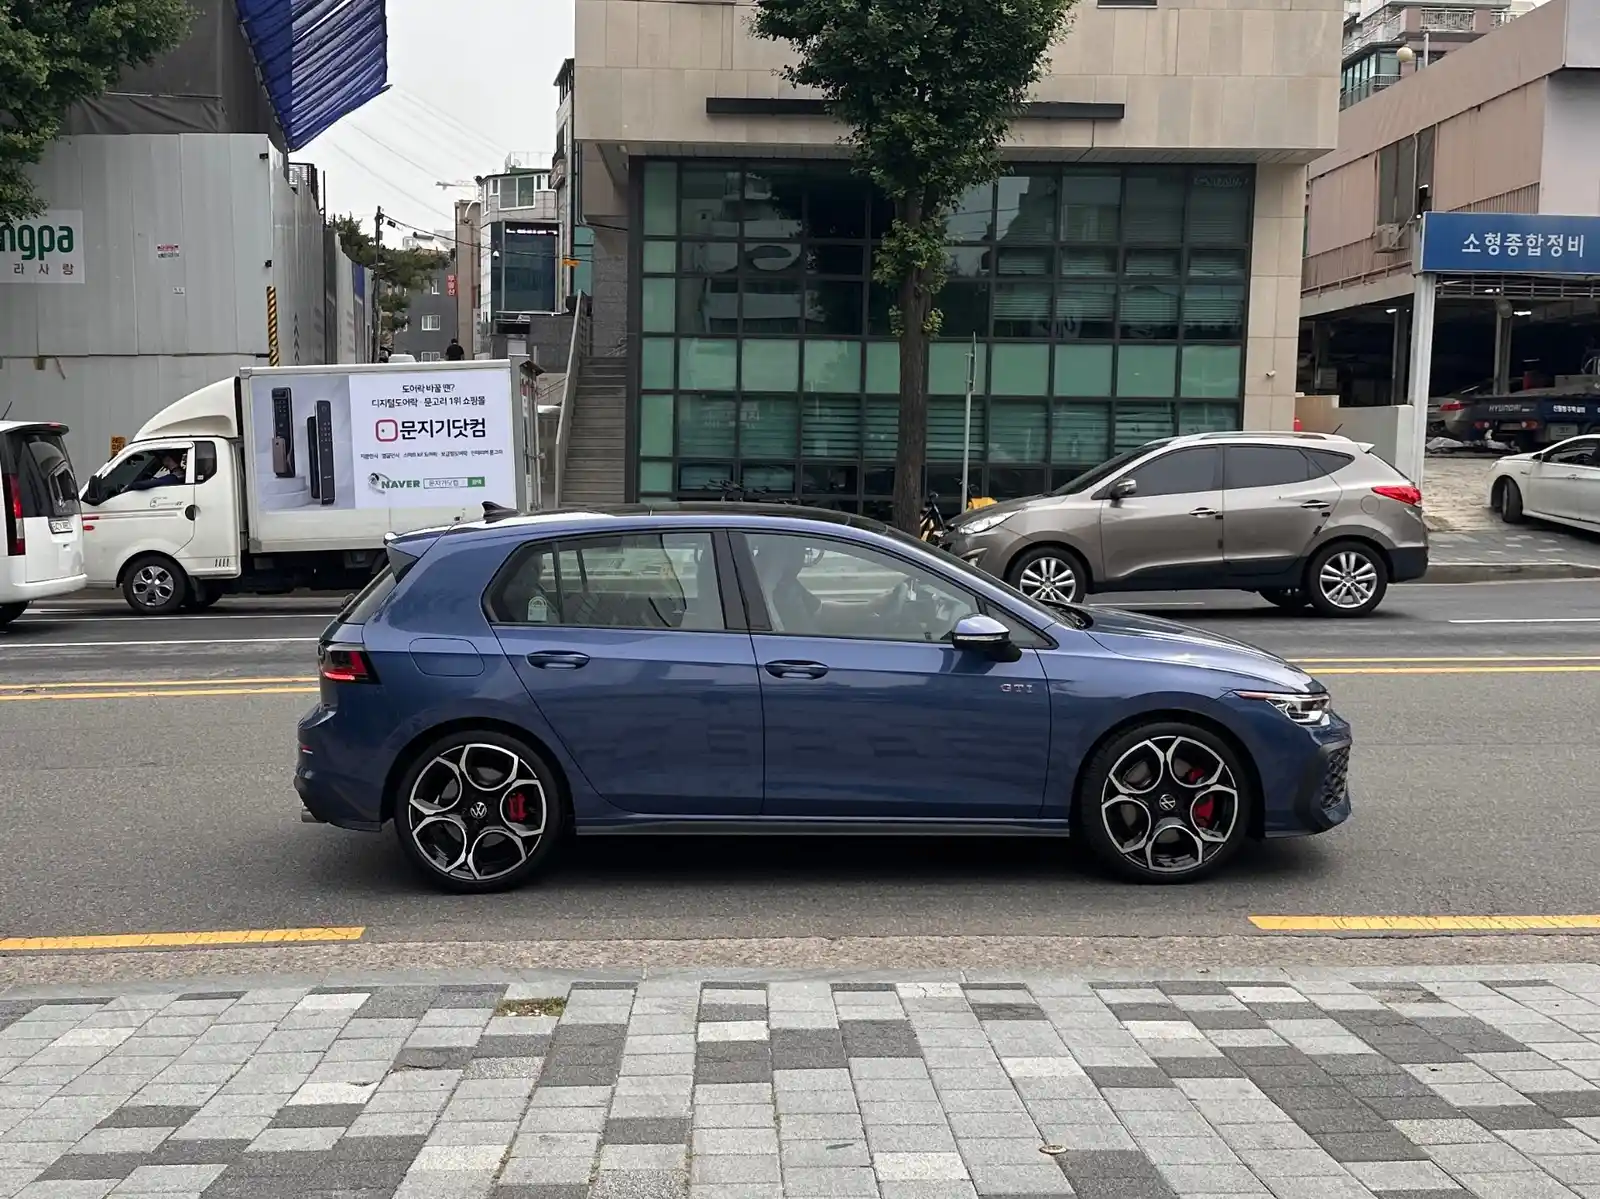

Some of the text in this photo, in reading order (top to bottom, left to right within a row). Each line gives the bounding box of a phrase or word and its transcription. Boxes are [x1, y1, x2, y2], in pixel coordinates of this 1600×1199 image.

[1461, 232, 1585, 258] 소형종합정비
[402, 384, 425, 393] 도어락
[425, 383, 441, 393] 바꿀
[371, 395, 486, 408] 디지털도어락 문고리 1위 쇼핑몰
[400, 418, 486, 440] 문지기닷컴
[381, 480, 421, 489] NAVER
[1000, 683, 1033, 693] GTI
